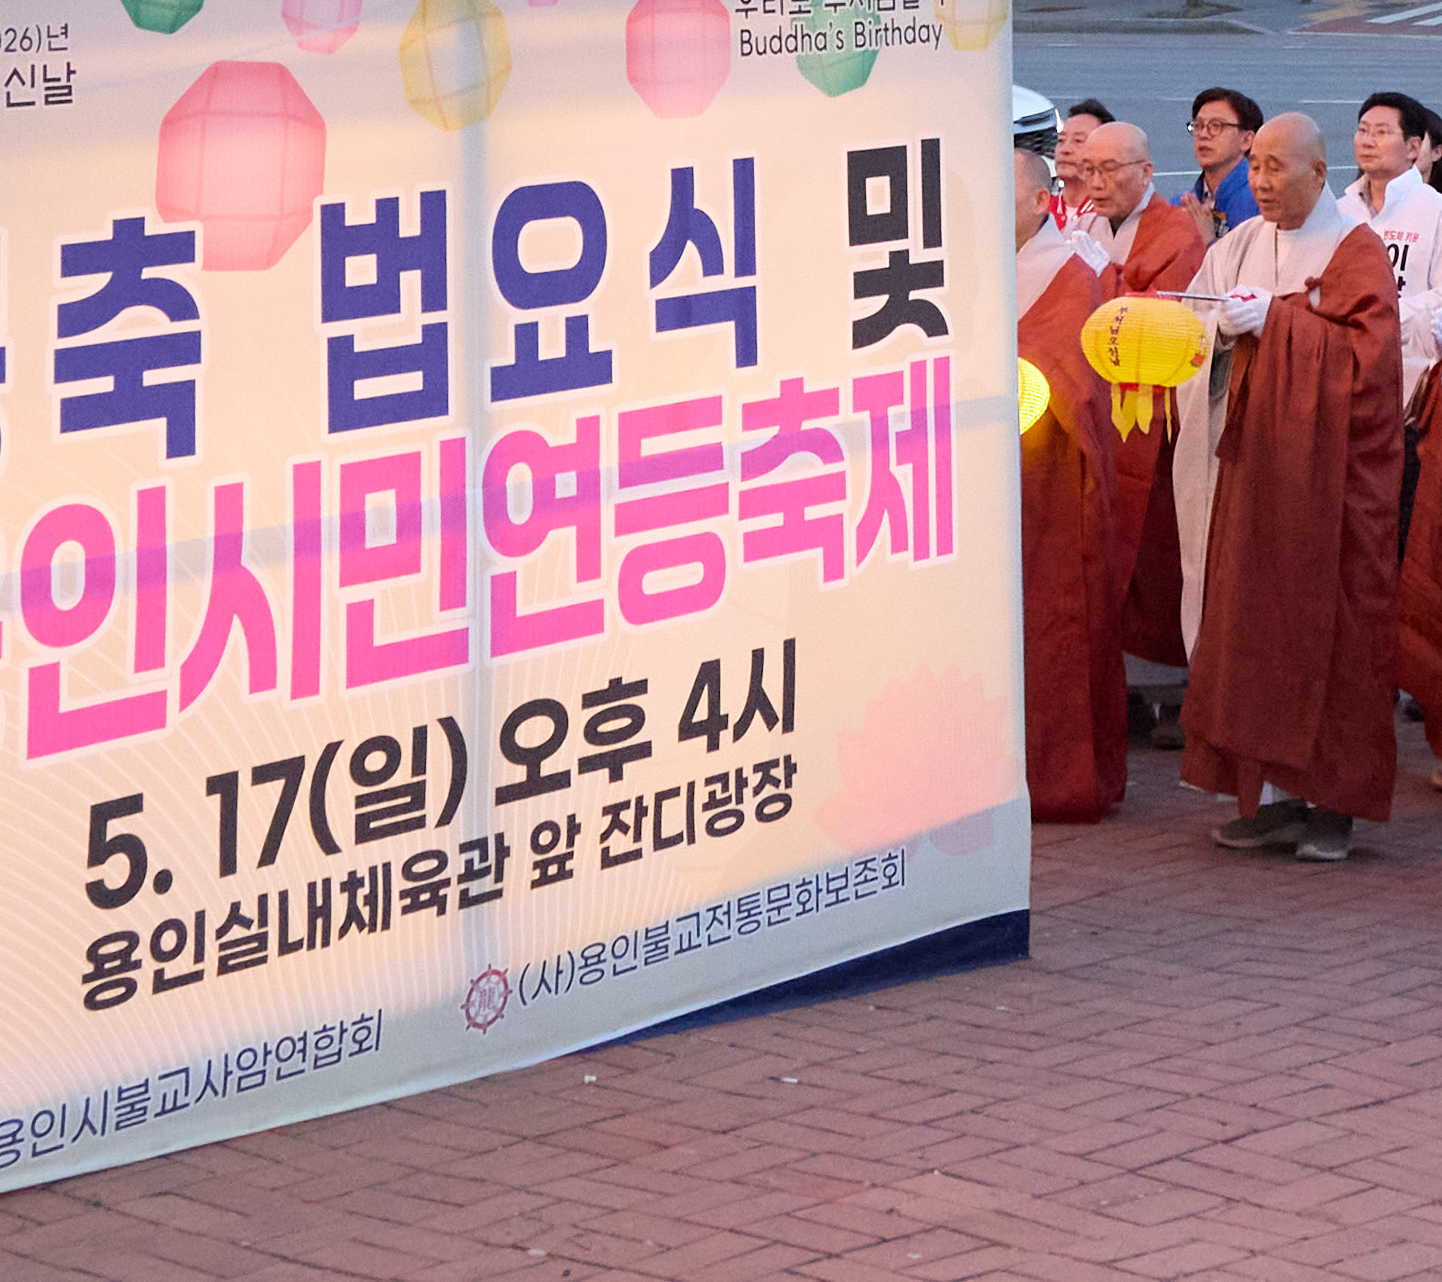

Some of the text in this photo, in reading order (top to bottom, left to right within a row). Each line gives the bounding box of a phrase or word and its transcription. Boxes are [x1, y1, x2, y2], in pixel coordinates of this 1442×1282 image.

[737, 19, 945, 60] Buddha's Birthday
[320, 154, 763, 437] 법요식
[845, 136, 950, 350] 및
[80, 753, 800, 1013] 용인실내체육관 앞 잔디광장
[85, 638, 799, 914] 5. 17(일) 오후 4시
[517, 846, 909, 1011] (사)용인불교전통문화보존회
